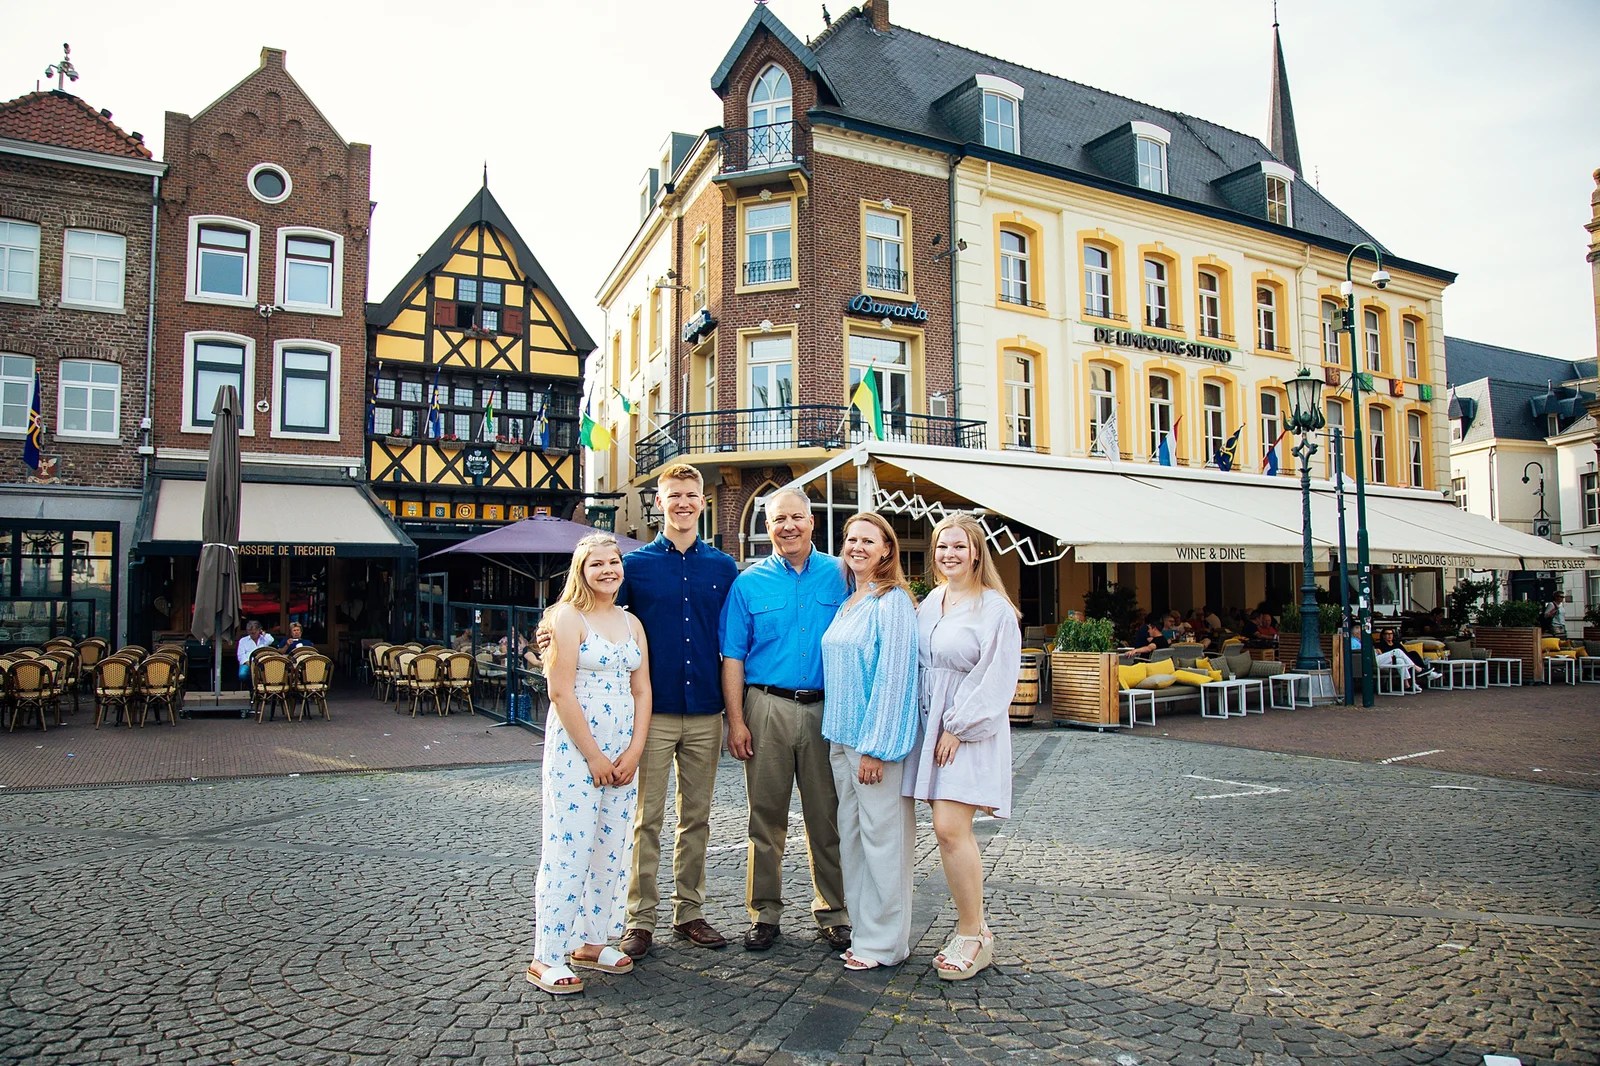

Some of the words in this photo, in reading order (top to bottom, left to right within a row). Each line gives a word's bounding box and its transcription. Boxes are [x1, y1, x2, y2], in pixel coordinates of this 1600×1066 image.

[851, 294, 929, 320] Bavaria
[1094, 327, 1115, 344] DE
[1115, 329, 1186, 355] LIMBOURG
[1186, 342, 1232, 363] SITTARD
[468, 454, 488, 462] Brand
[278, 545, 290, 556] DE
[293, 545, 336, 556] TRECHTER
[1176, 547, 1207, 560] WINE
[1209, 547, 1217, 560] &
[1219, 547, 1246, 560] DINE
[1392, 553, 1403, 564] DE
[1405, 554, 1447, 566] LIMBOURG
[1448, 555, 1476, 567] SITTARD
[1543, 560, 1560, 569] MEET
[1562, 560, 1567, 569] &
[1567, 560, 1586, 569] SLEEP
